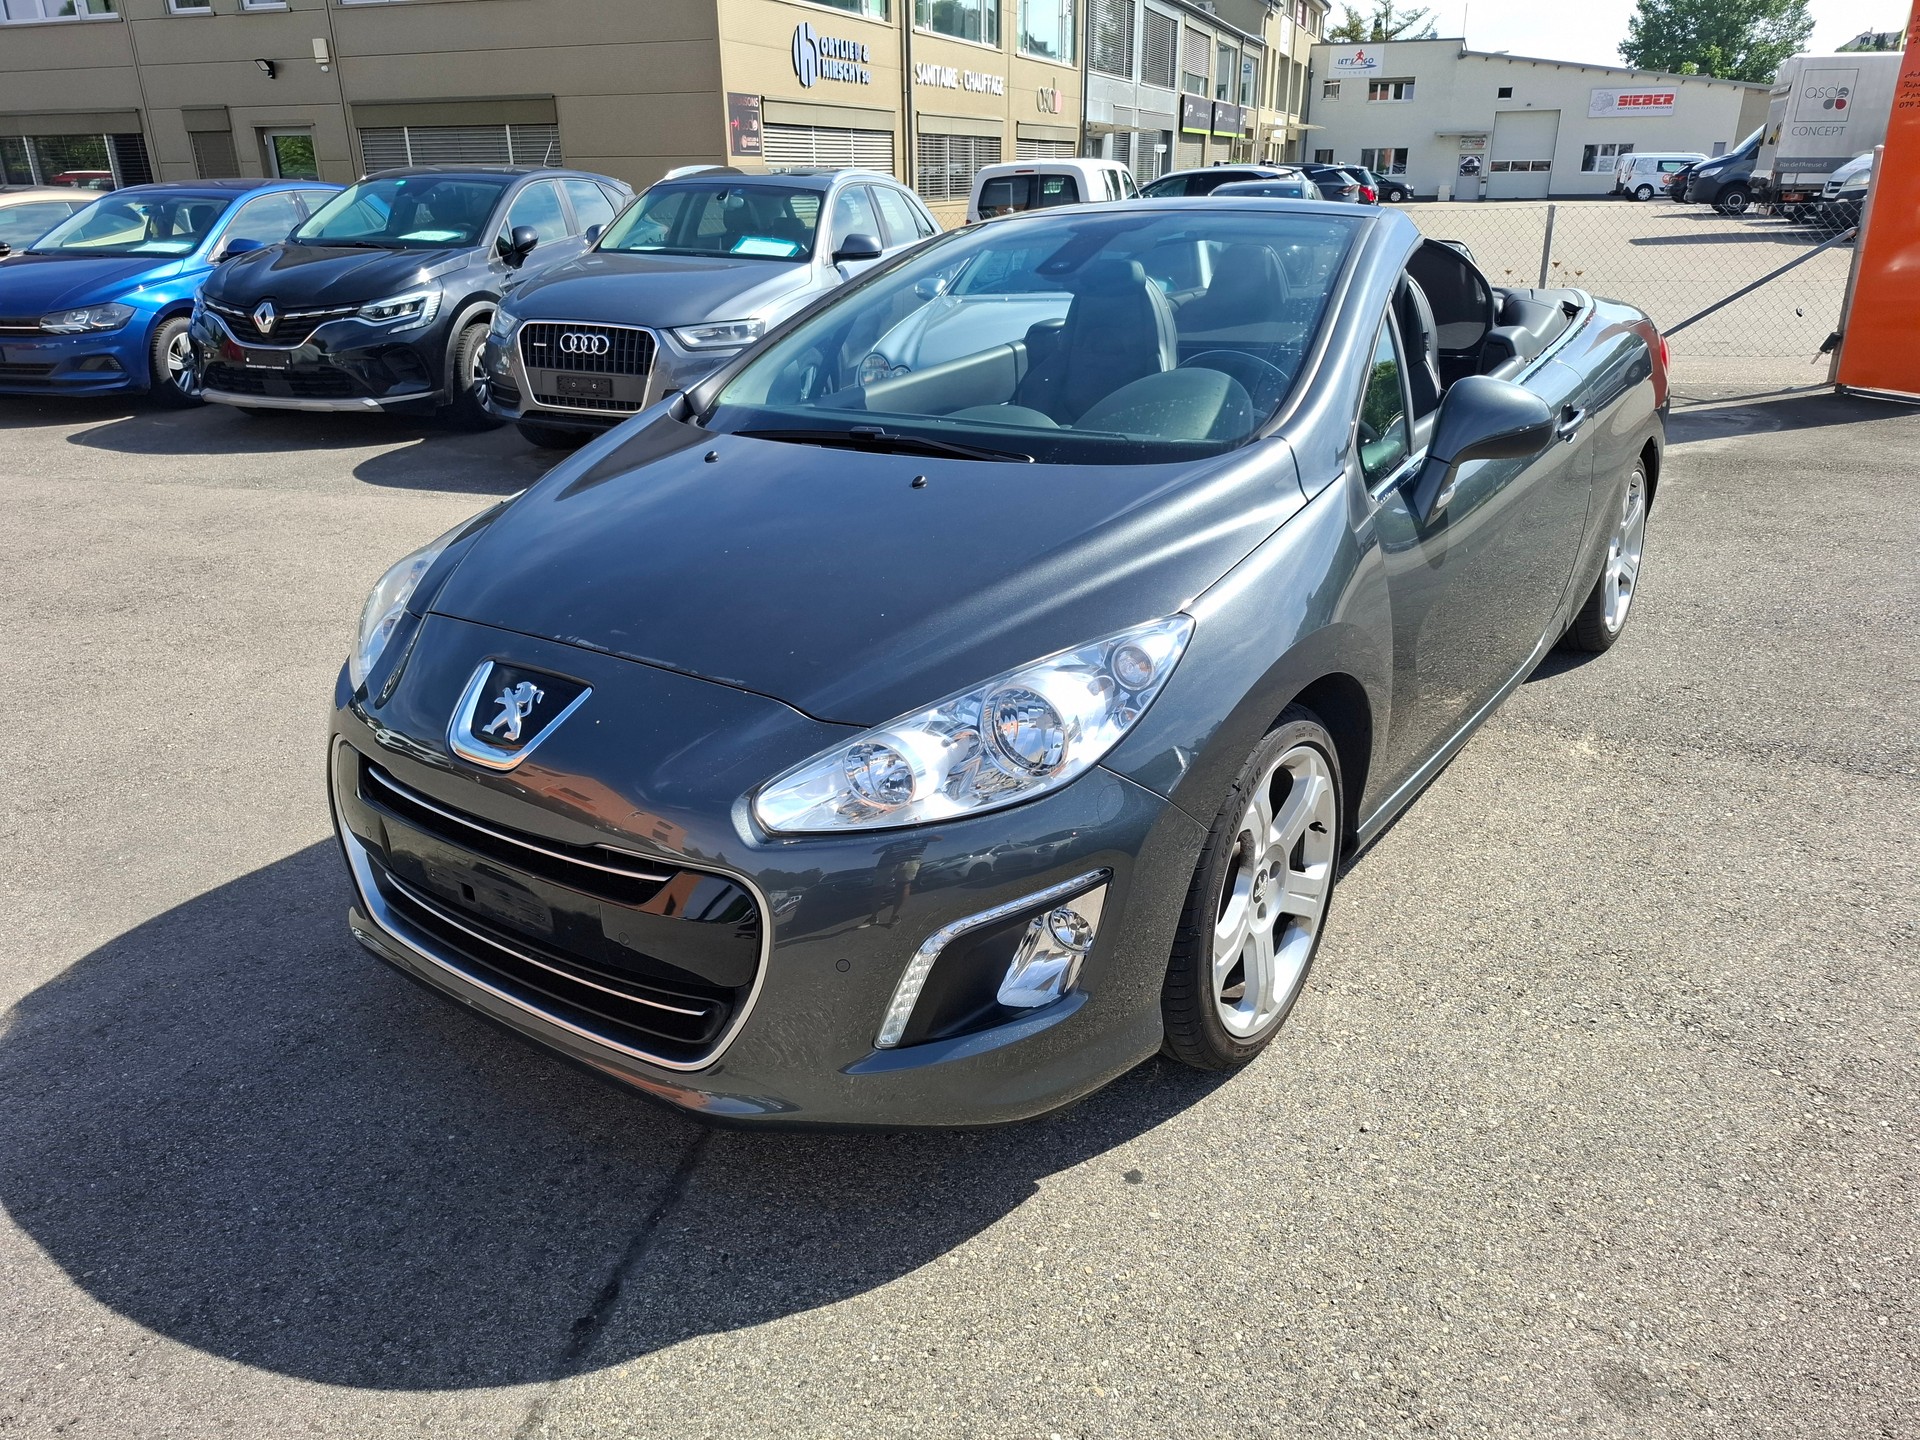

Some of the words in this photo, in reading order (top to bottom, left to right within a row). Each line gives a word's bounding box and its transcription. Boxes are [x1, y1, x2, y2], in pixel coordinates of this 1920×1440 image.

[819, 37, 860, 62] ORTLIEB
[861, 44, 870, 64] &
[820, 58, 861, 84] HIRSCHY
[914, 61, 959, 90] SANITAIRE
[963, 69, 1005, 96] CHAUFFAGE
[1618, 94, 1674, 106] SIEBER
[1791, 126, 1847, 136] CONCEPT
[1221, 766, 1262, 859] GOODYEAR
